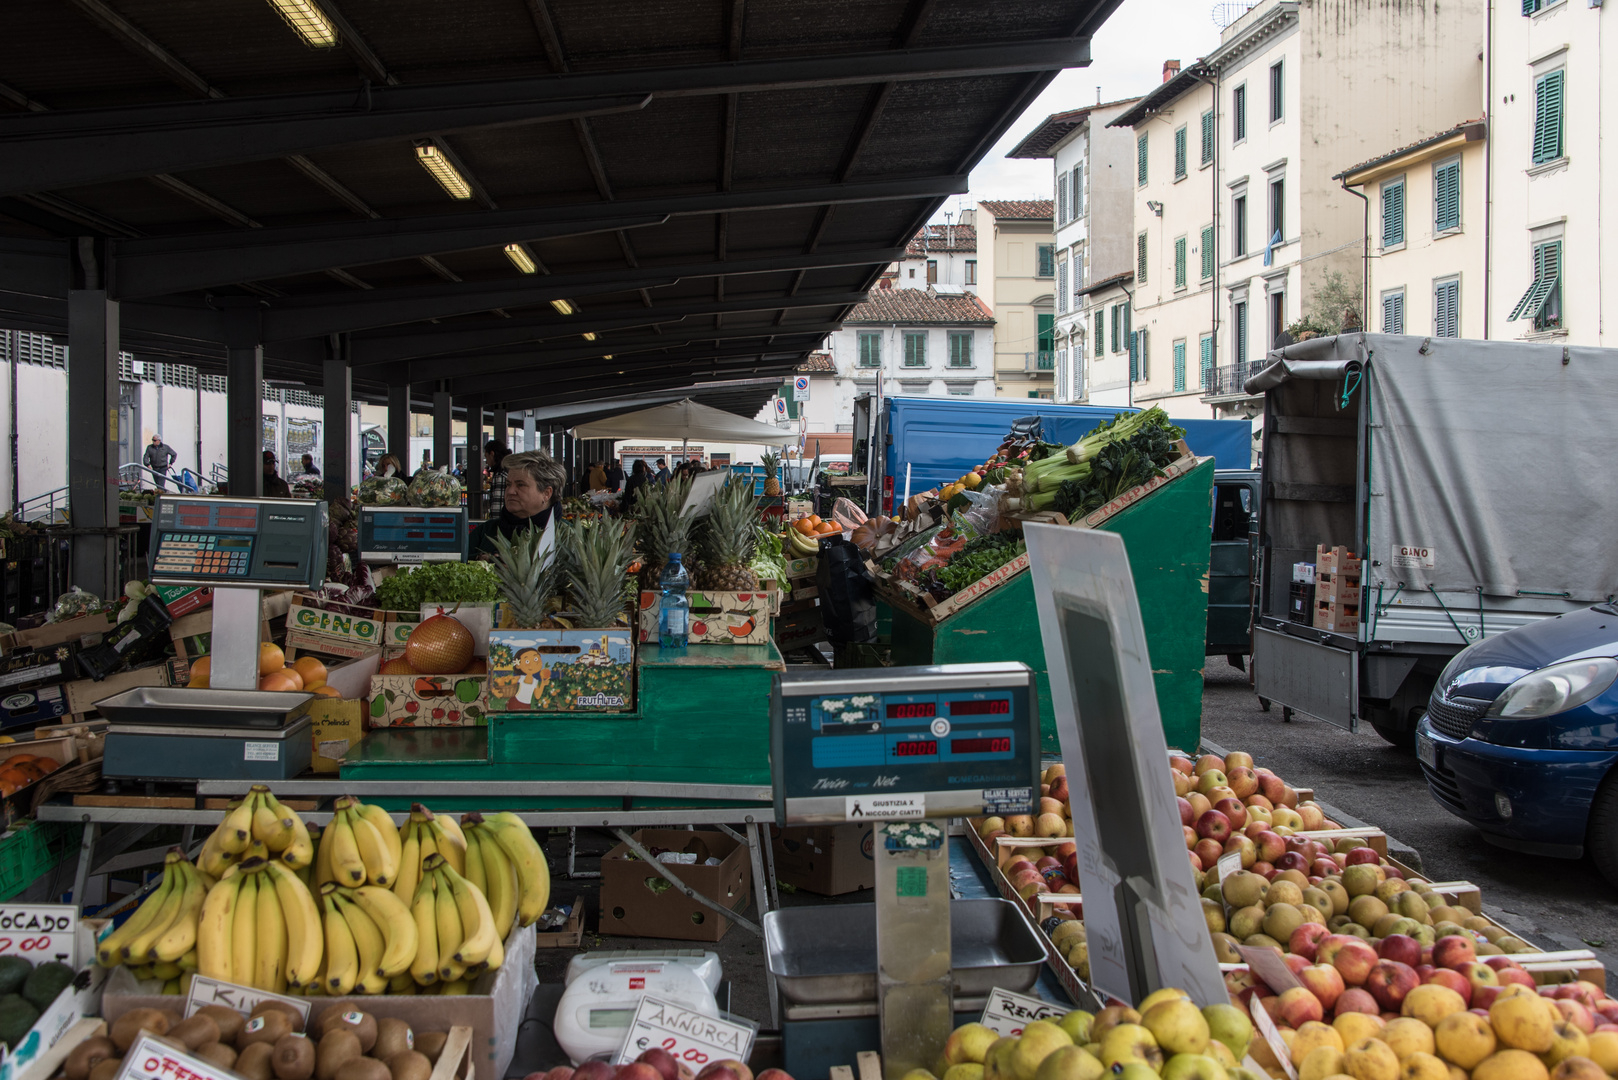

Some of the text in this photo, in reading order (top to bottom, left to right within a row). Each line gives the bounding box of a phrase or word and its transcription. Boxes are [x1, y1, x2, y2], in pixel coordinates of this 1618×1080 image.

[1401, 547, 1428, 557] GANO
[297, 609, 374, 638] GINO
[578, 693, 624, 705] FRUTALTEA
[812, 777, 850, 790] Twin
[873, 775, 900, 787] Net
[648, 1005, 738, 1051] ANNURCA
